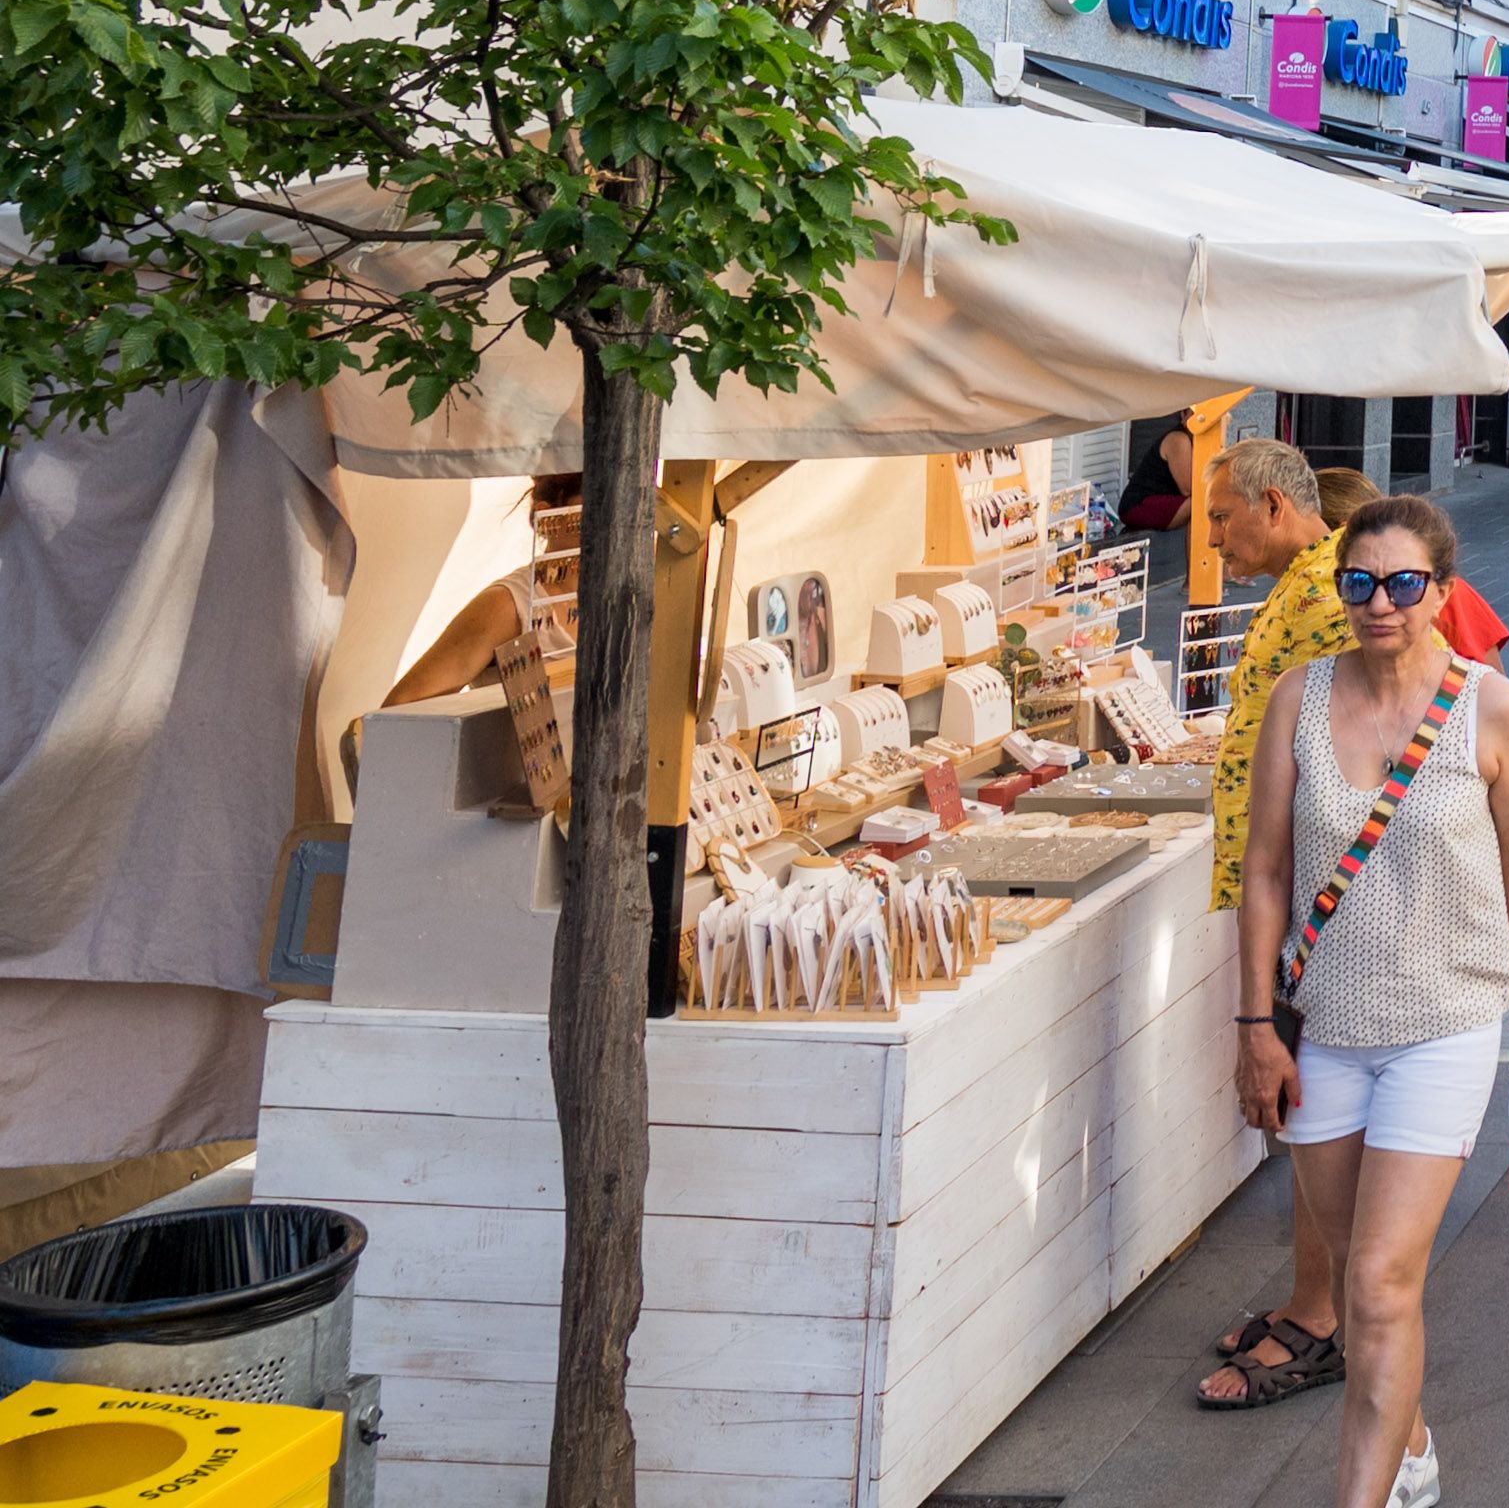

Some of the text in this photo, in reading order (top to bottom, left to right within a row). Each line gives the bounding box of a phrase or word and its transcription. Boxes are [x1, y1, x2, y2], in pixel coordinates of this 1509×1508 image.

[1277, 60, 1317, 74] Condis
[1323, 18, 1408, 97] Condis
[1470, 112, 1503, 124] Condis
[98, 1400, 219, 1421] ENVASOS
[137, 1446, 239, 1501] ENVASOS
